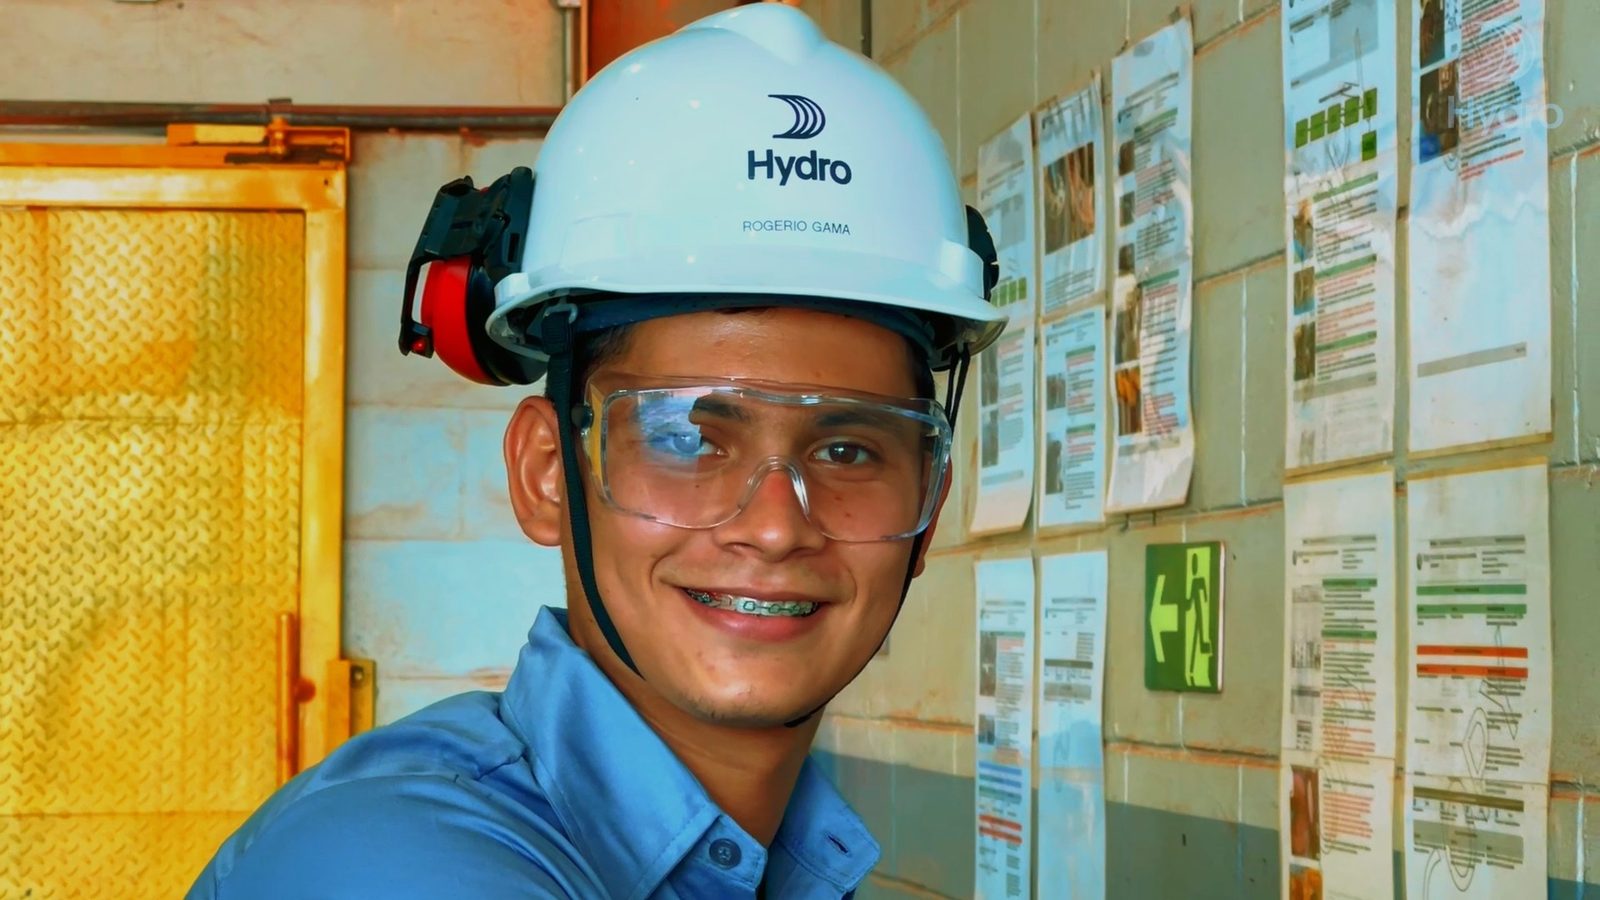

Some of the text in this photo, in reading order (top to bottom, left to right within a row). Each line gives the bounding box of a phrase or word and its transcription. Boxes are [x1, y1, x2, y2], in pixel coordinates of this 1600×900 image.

[747, 149, 852, 186] Hydro
[742, 220, 851, 235] ROGERIO GAMA
